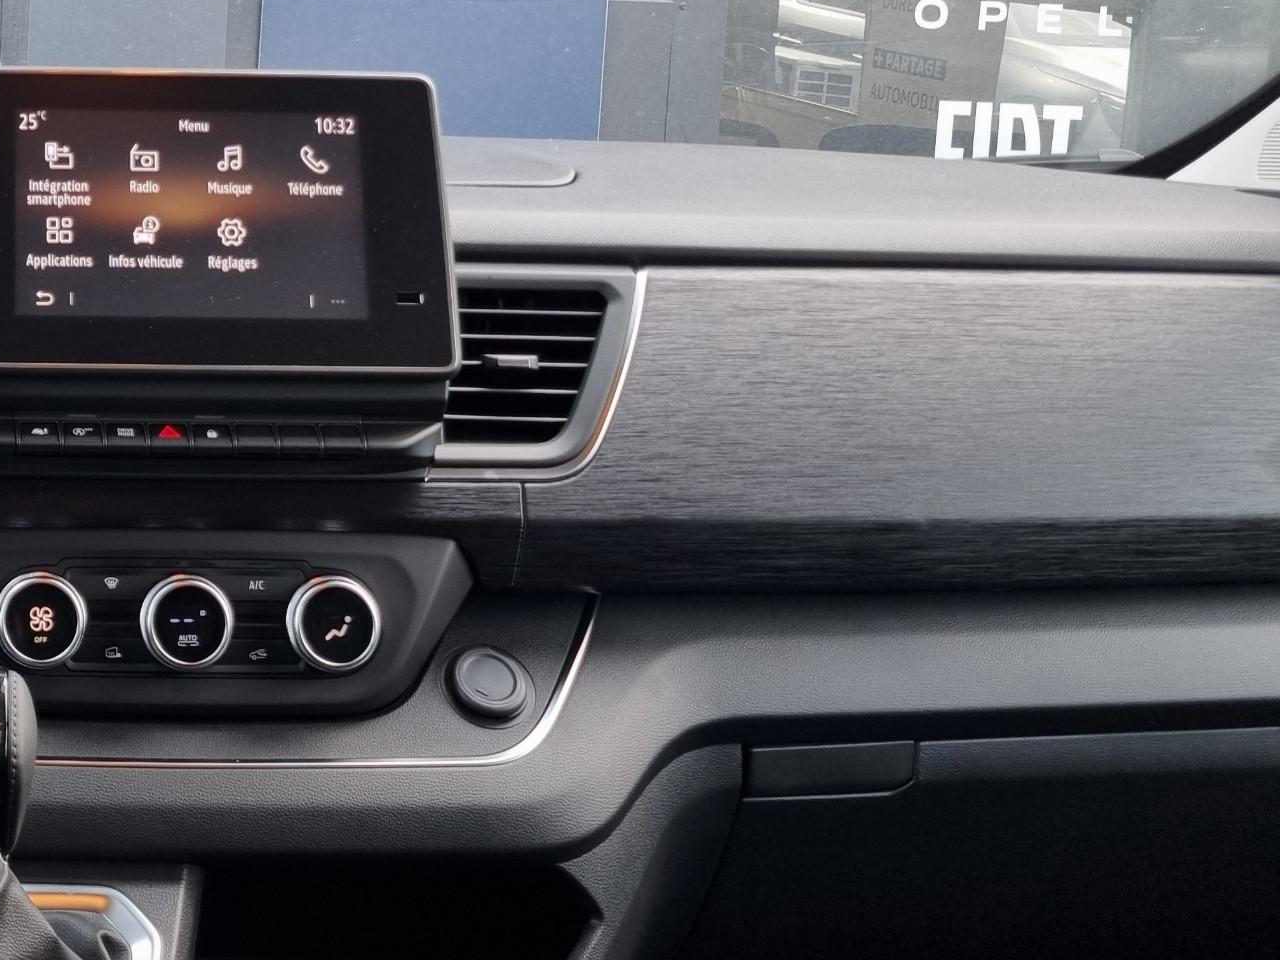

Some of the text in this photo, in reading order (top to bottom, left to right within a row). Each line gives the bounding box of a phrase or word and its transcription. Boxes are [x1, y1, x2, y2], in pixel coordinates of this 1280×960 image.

[178, 119, 210, 133] Menu
[314, 117, 356, 135] 10:32
[28, 179, 89, 194] Intégration
[129, 180, 160, 193] Radio
[207, 181, 252, 197] Musique
[287, 182, 343, 198] Téléphone
[26, 193, 91, 208] smartphone
[25, 253, 94, 269] Applications
[108, 254, 183, 269] Infos véhicule
[207, 254, 258, 273] Réglages
[248, 579, 266, 591] A/C
